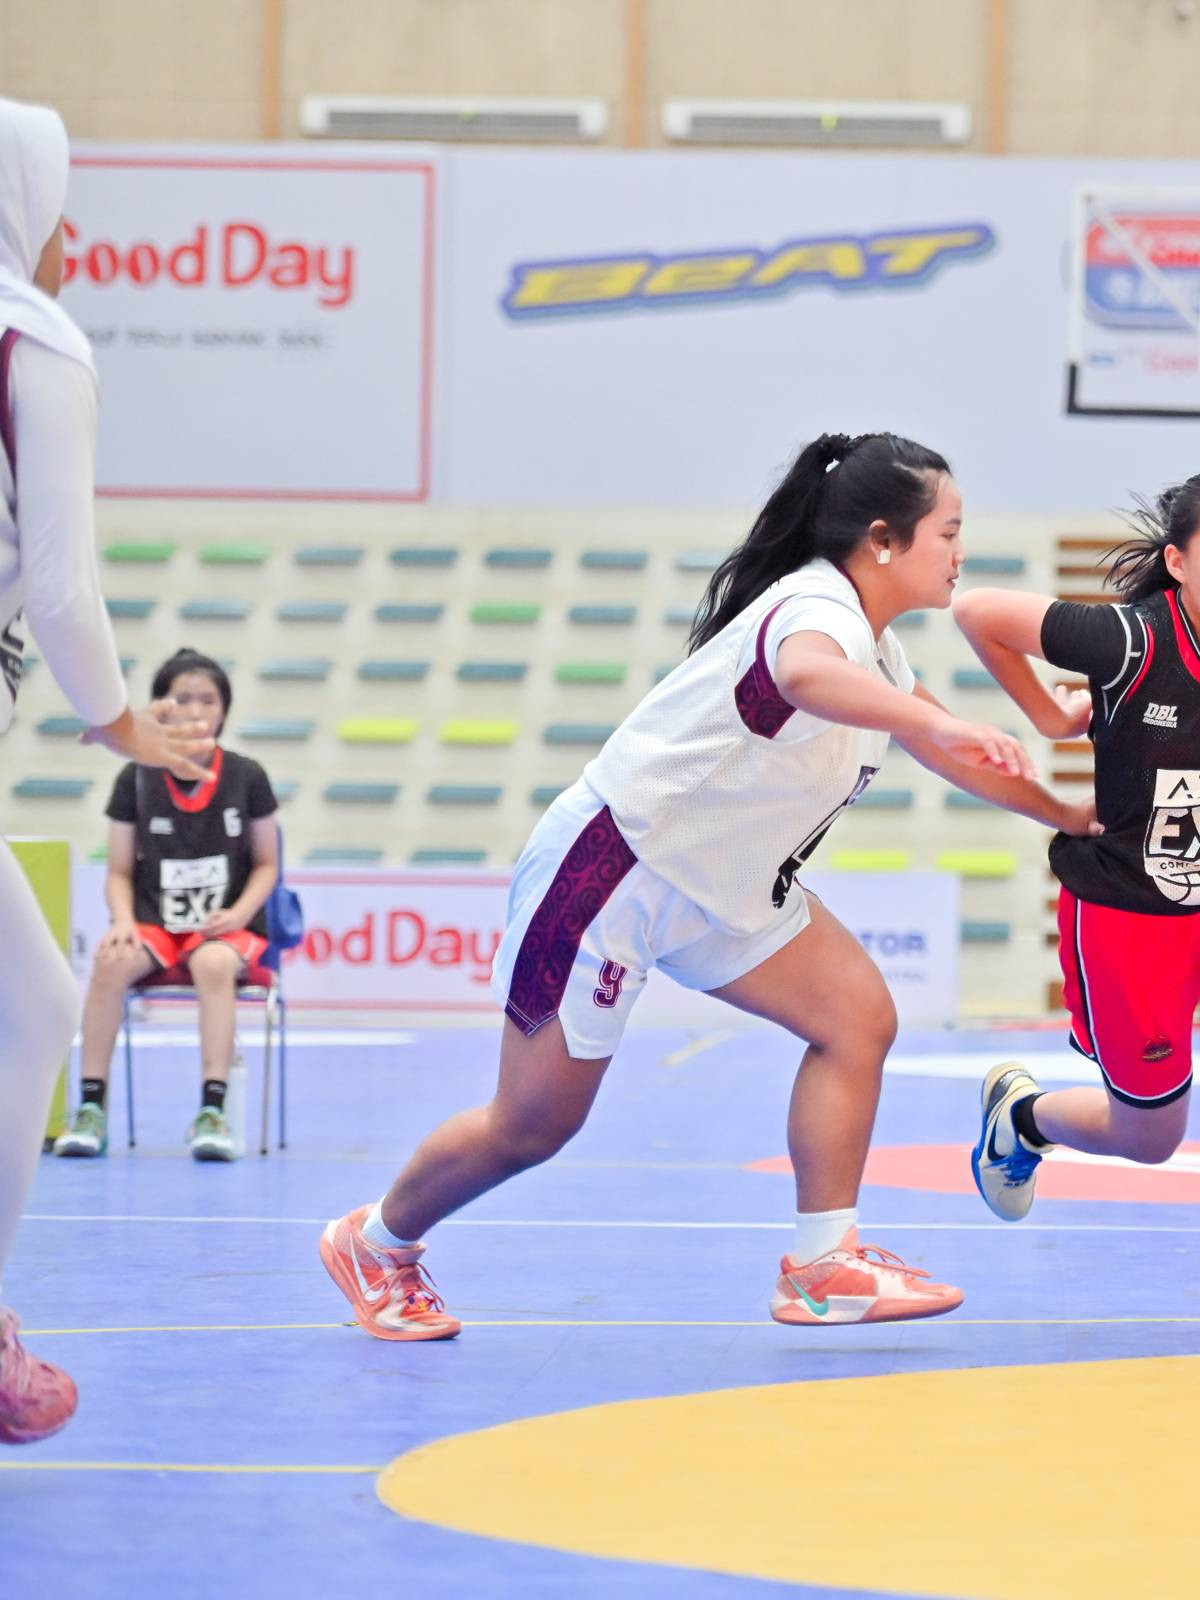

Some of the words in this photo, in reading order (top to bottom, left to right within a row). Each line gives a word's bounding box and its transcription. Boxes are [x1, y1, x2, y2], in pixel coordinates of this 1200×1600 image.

[222, 220, 356, 309] Day
[1143, 702, 1178, 722] DBL
[223, 807, 242, 838] 6
[387, 909, 503, 986] Day
[861, 930, 926, 957] TOR
